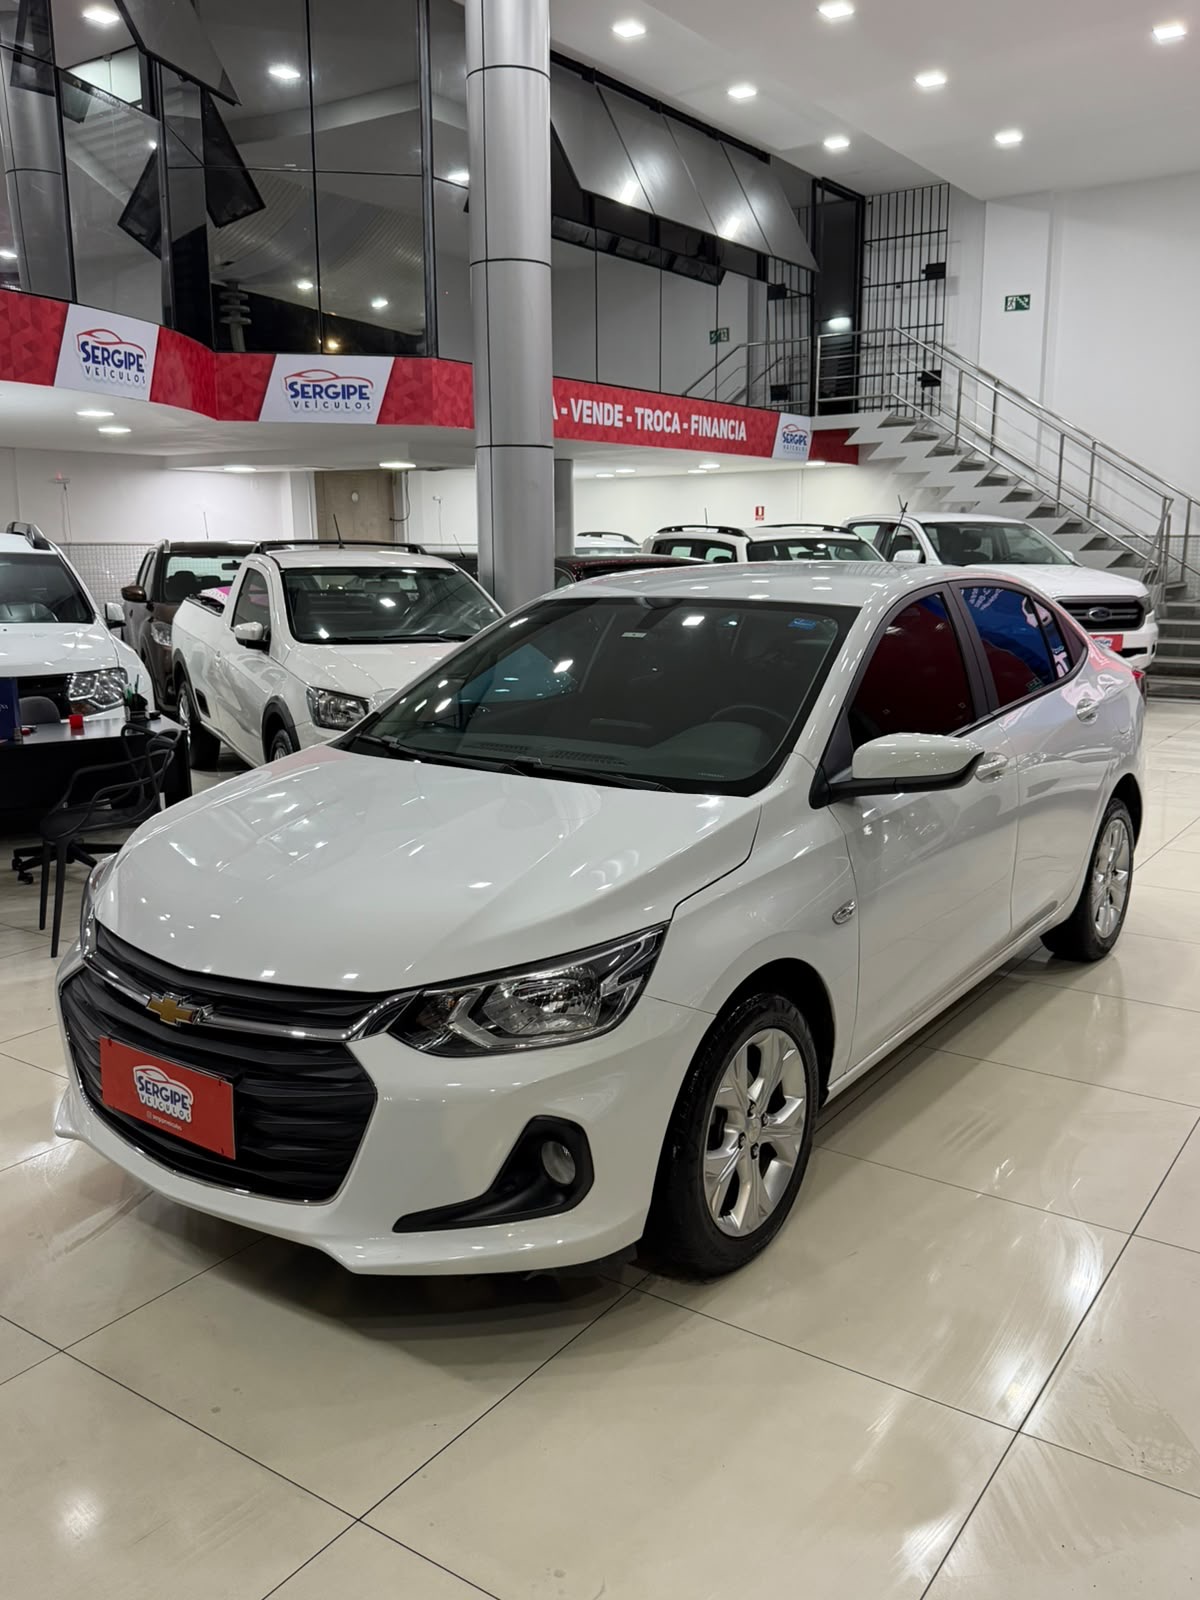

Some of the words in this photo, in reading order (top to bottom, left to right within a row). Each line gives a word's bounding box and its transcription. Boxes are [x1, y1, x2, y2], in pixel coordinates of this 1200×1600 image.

[80, 340, 145, 373] SERGIPE
[288, 381, 370, 400] SERGIPE
[570, 398, 623, 428] VENDE
[634, 406, 681, 434] TROCA
[690, 414, 747, 441] FINANCIA
[137, 1075, 189, 1110] SERGIPE
